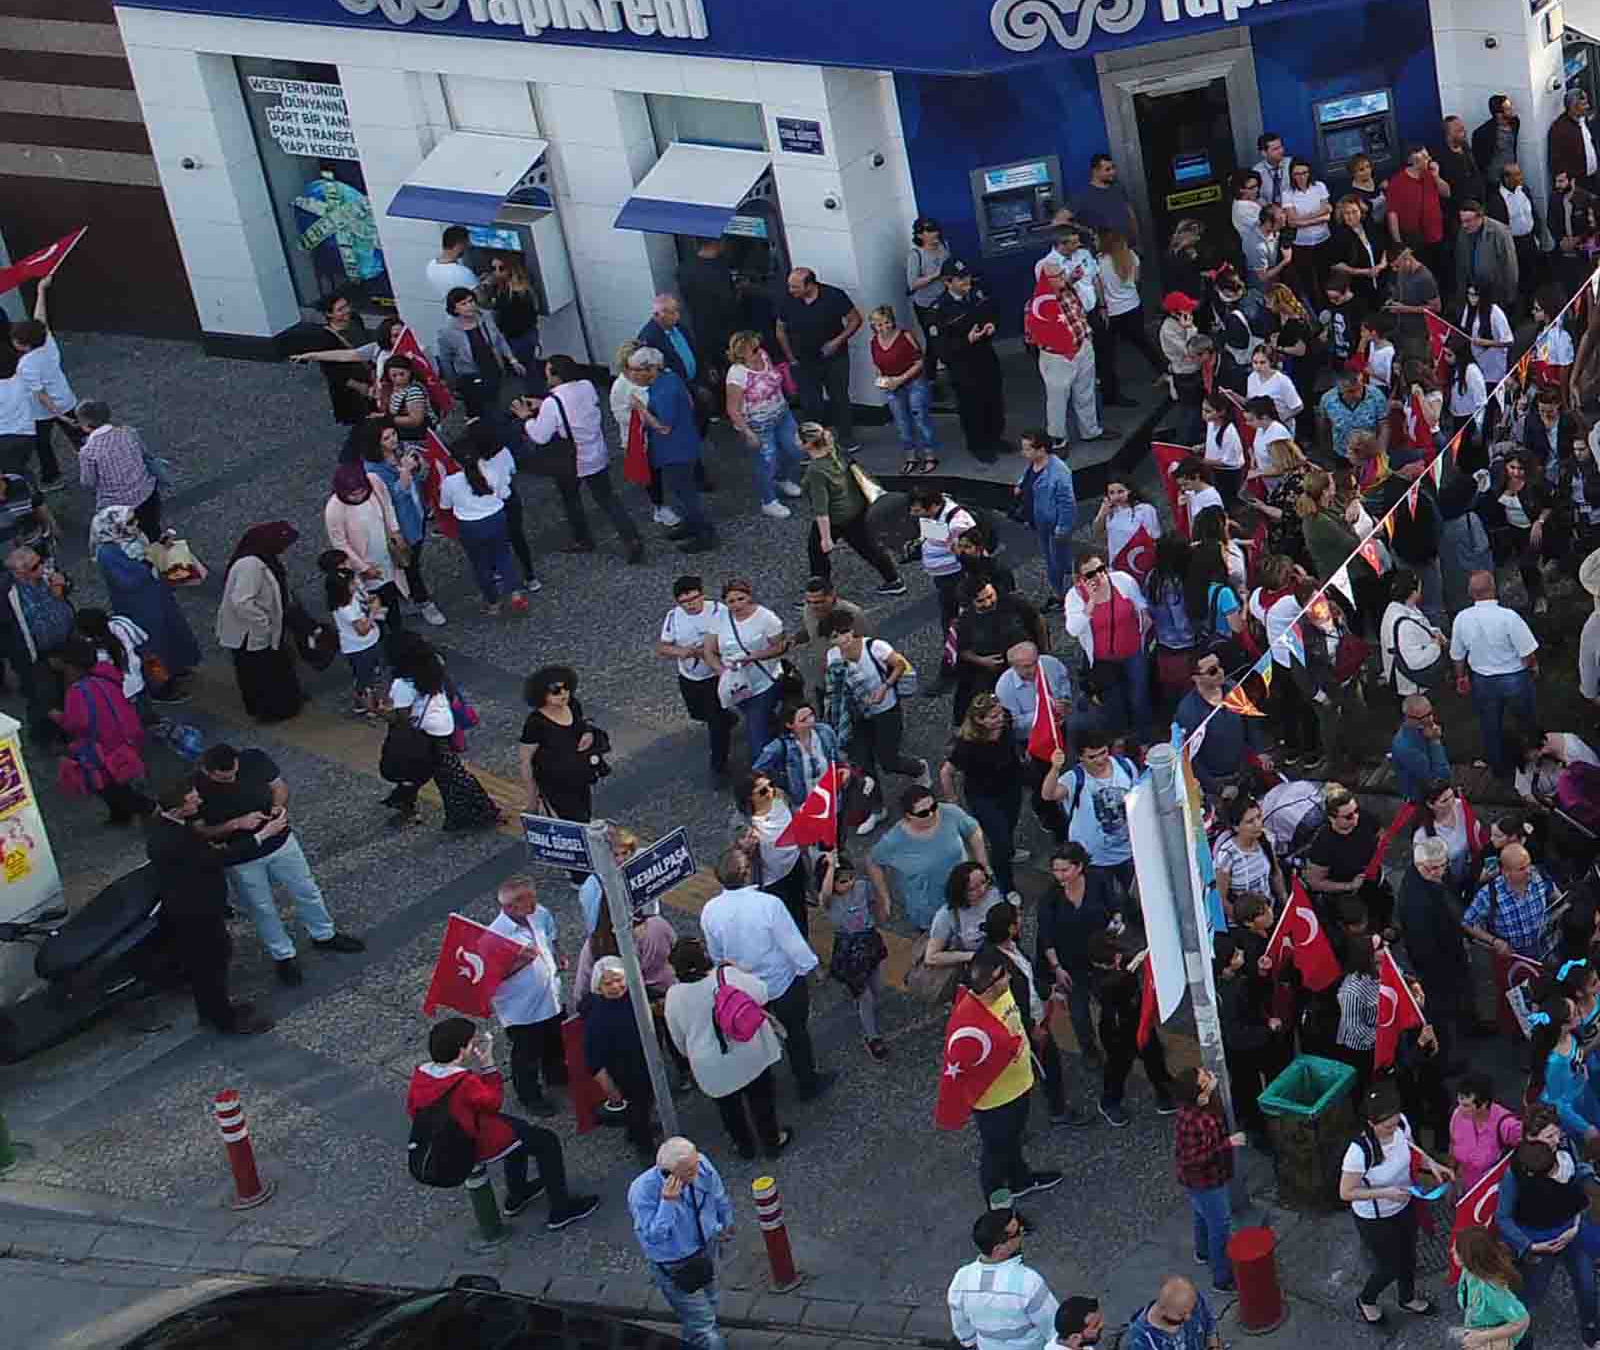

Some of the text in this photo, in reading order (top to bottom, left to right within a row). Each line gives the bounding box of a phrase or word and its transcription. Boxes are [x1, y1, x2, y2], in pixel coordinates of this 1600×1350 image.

[250, 76, 309, 94] WESTERN
[268, 108, 300, 123] DÖRT
[303, 111, 321, 125] BİR
[271, 124, 304, 138] PARA
[281, 140, 309, 154] YAPI
[628, 844, 690, 892] KEMALPAŞA
